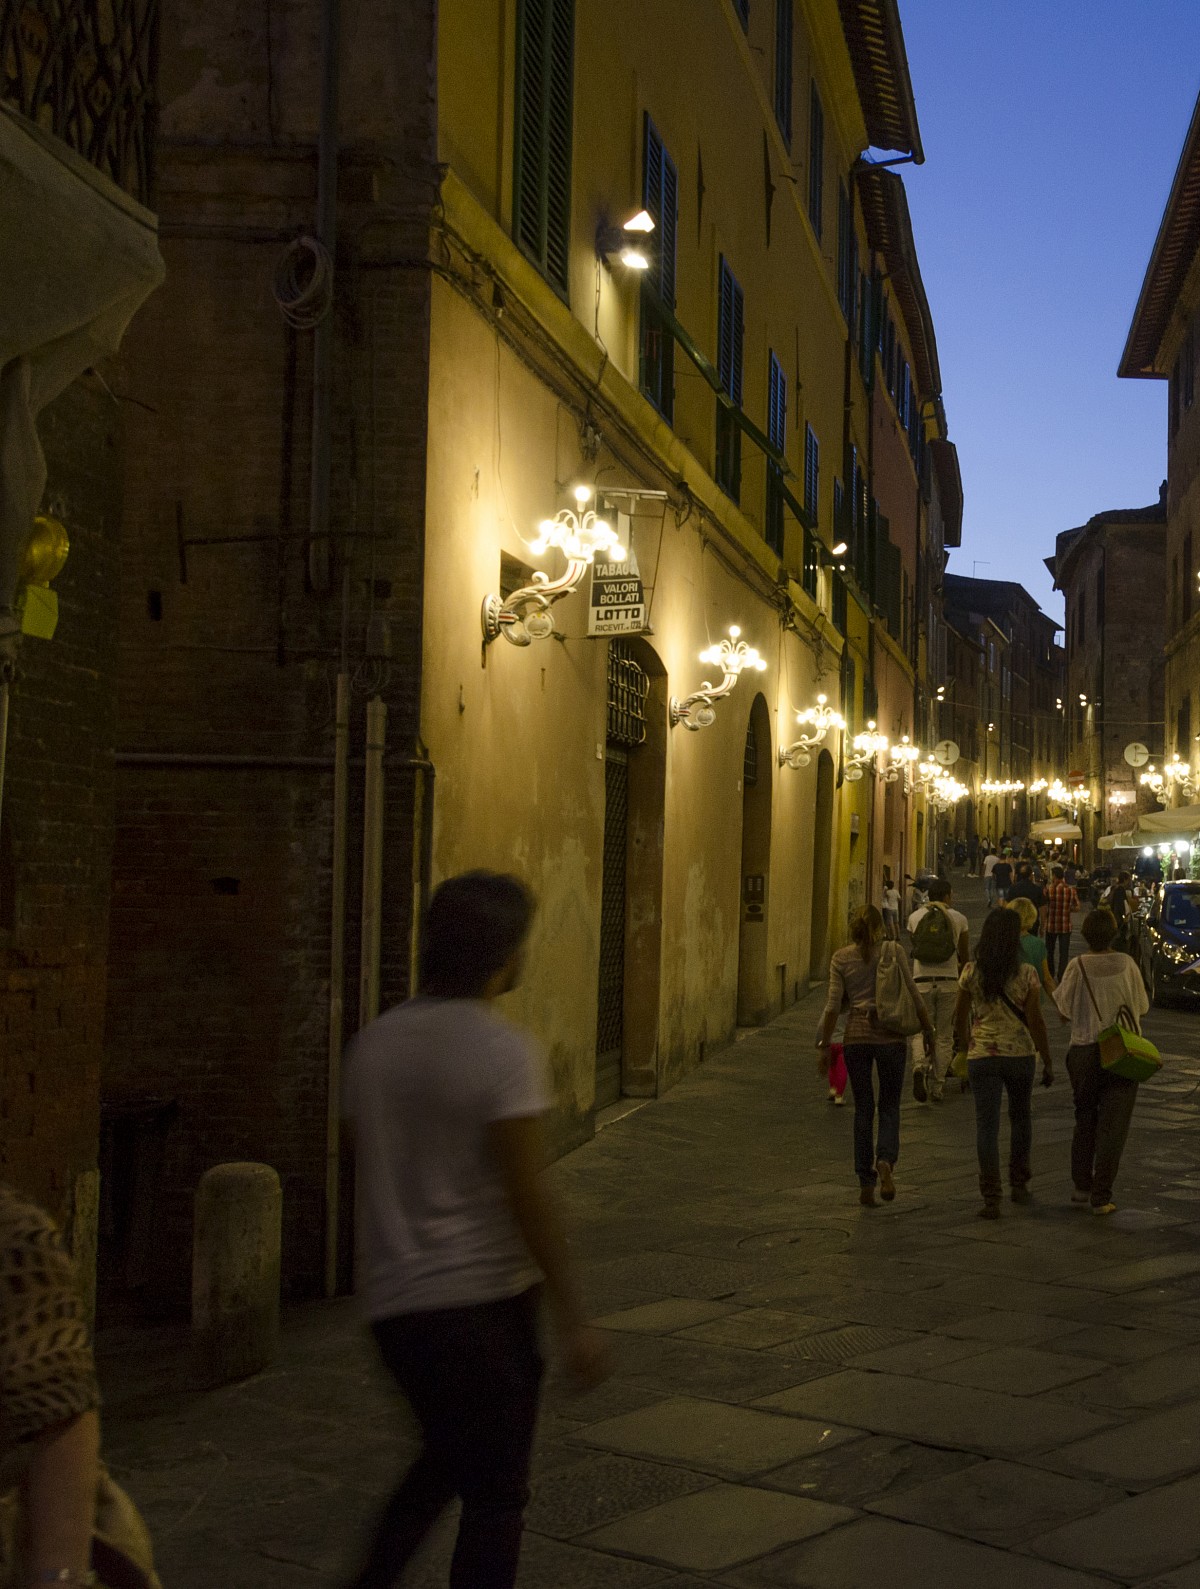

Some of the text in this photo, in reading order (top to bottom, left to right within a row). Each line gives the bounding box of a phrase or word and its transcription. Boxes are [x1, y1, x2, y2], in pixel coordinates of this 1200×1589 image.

[603, 582, 638, 593] VALORI
[600, 592, 639, 604] BOLLATI
[596, 607, 640, 621] LOTTO
